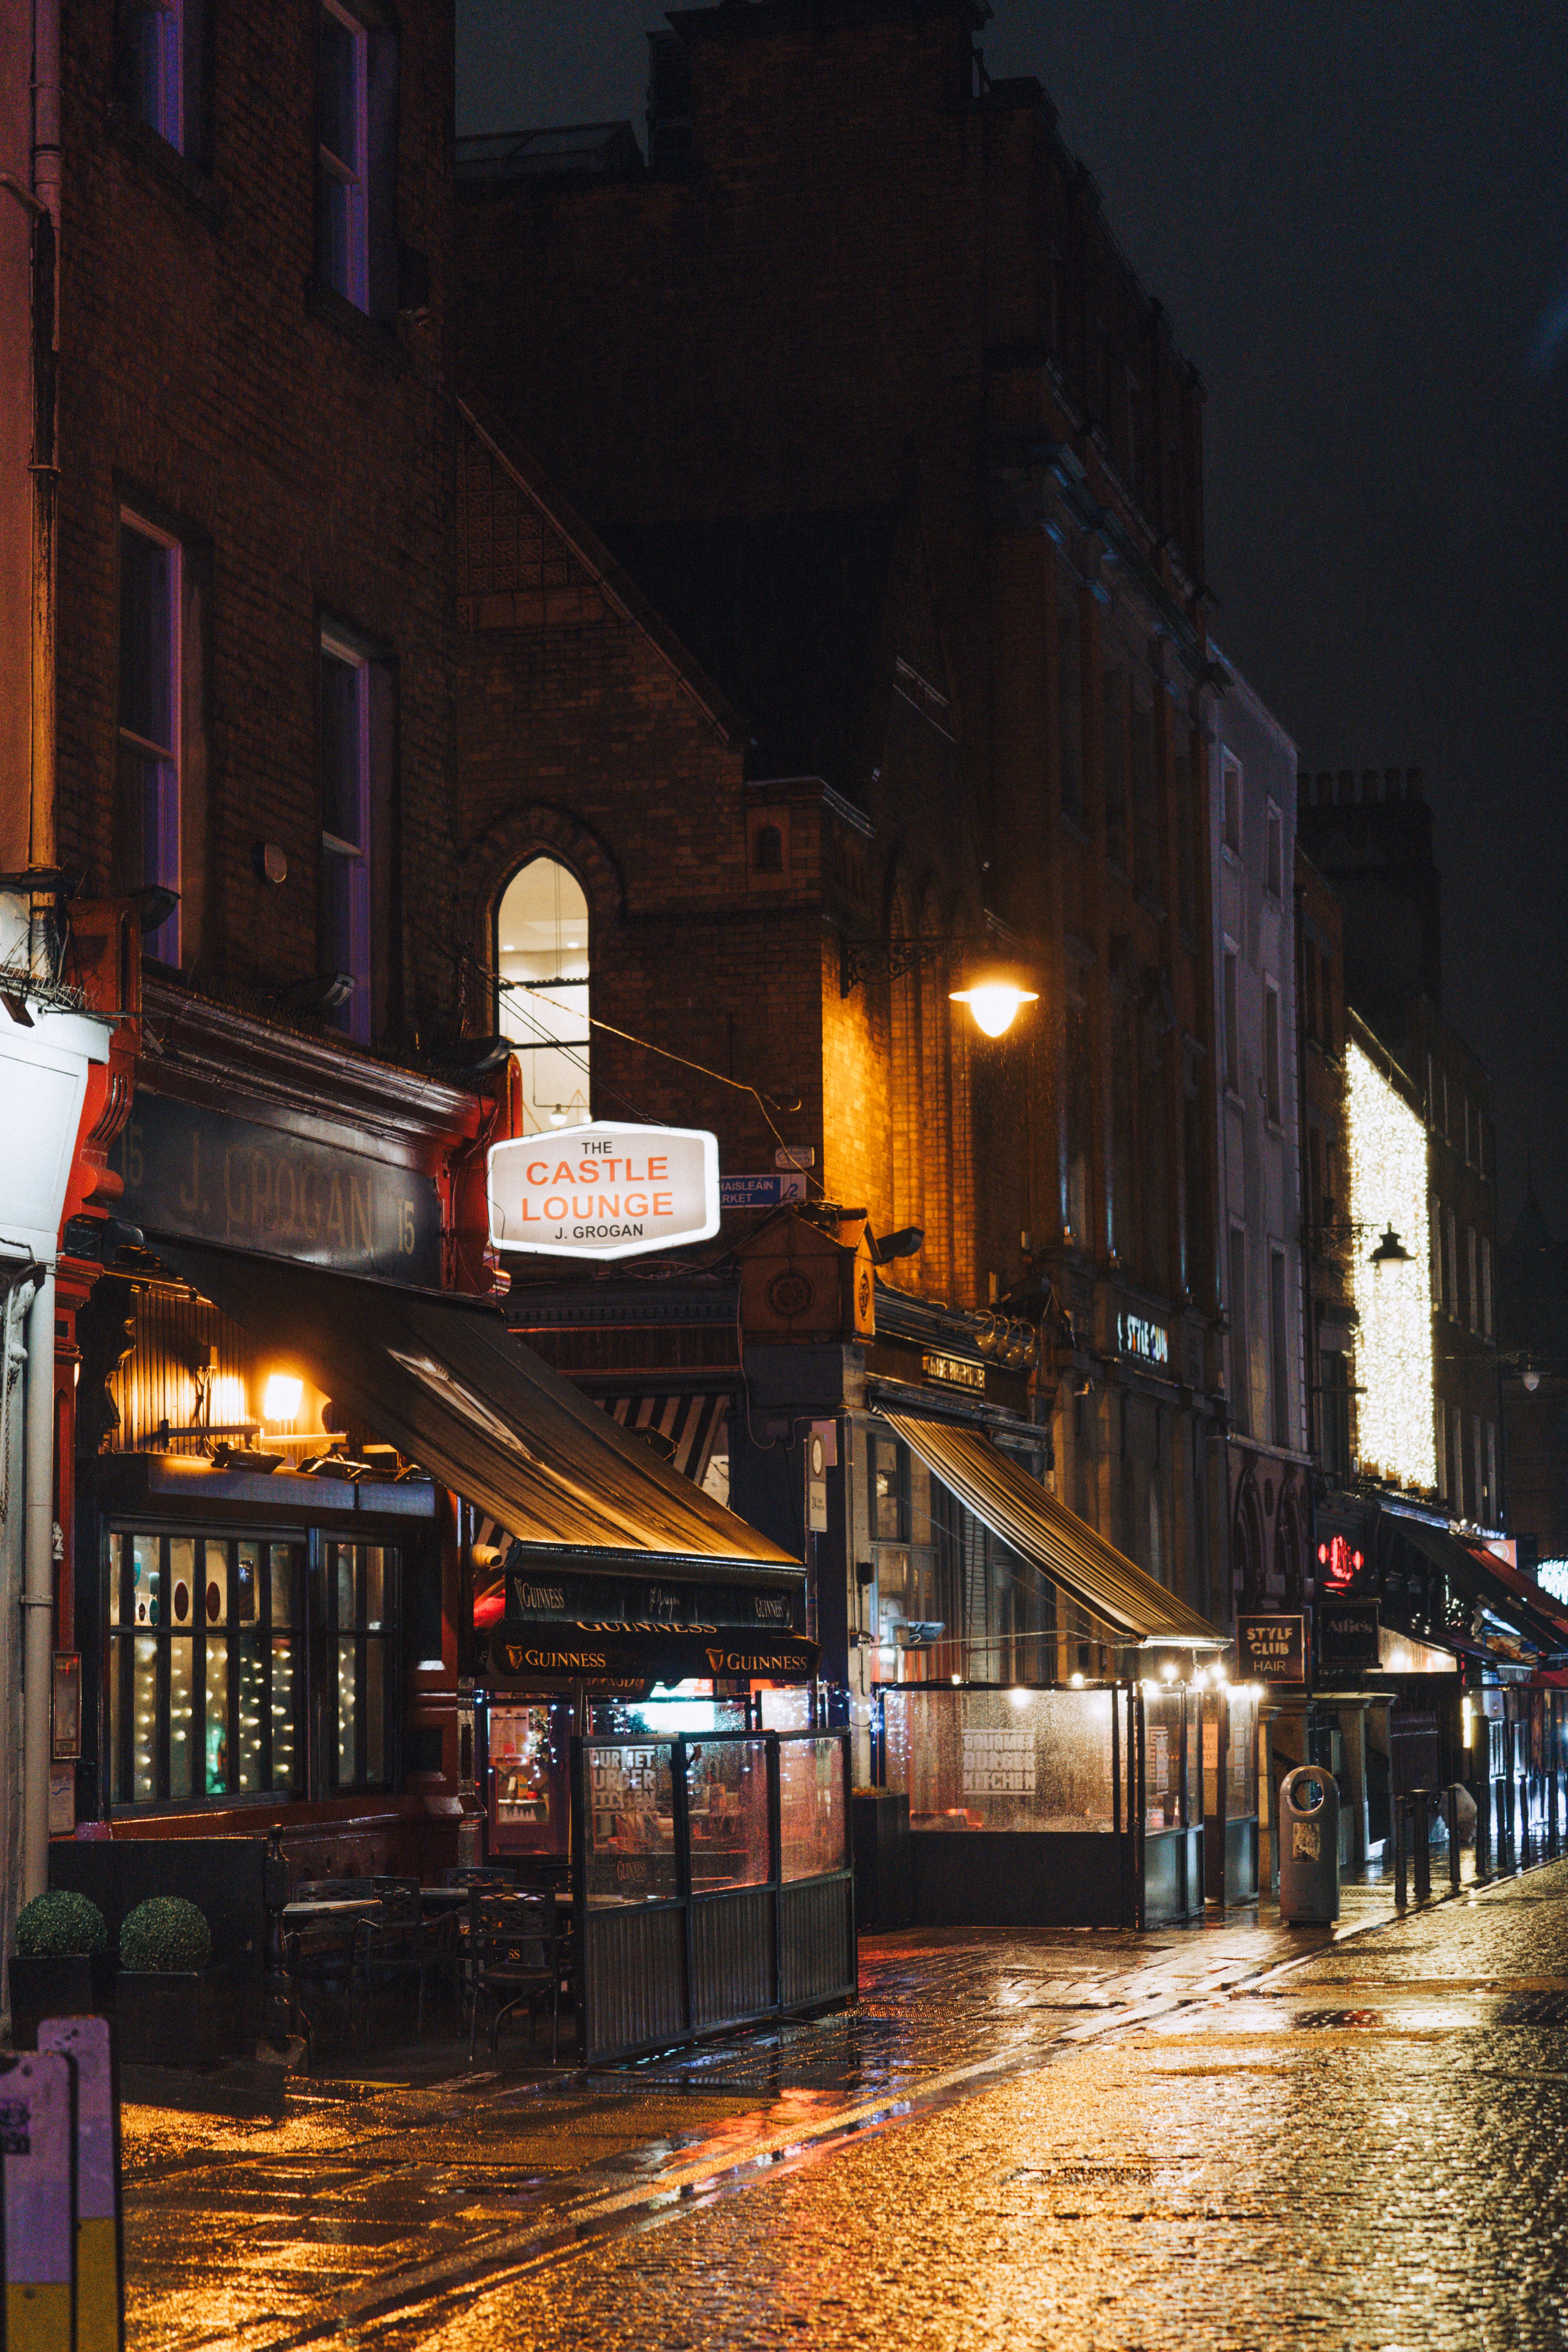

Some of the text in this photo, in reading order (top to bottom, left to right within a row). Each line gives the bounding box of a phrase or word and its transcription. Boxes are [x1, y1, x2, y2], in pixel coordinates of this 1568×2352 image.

[582, 1142, 612, 1154] THE
[526, 1156, 668, 1185] CASTLE
[720, 1178, 773, 1191] HAISLEÁIN
[789, 1183, 798, 1197] 2
[522, 1192, 673, 1221] LOUNGE
[722, 1194, 752, 1203] RKET
[398, 1198, 415, 1254] 15
[555, 1224, 643, 1239] J. GROGAN
[523, 1583, 564, 1608] GUINNESS
[755, 1597, 784, 1618] GUINNESS
[1250, 1642, 1289, 1655] CLUB
[525, 1650, 606, 1668] GUINNESS
[727, 1653, 808, 1671] GUINNESS
[1254, 1661, 1285, 1671] HAIR
[964, 1735, 1034, 1749] GOURMET
[590, 1751, 655, 1768] OURMET
[963, 1751, 1036, 1771] BURGER
[593, 1769, 656, 1790] URGER
[964, 1772, 1036, 1789] KITCHEN
